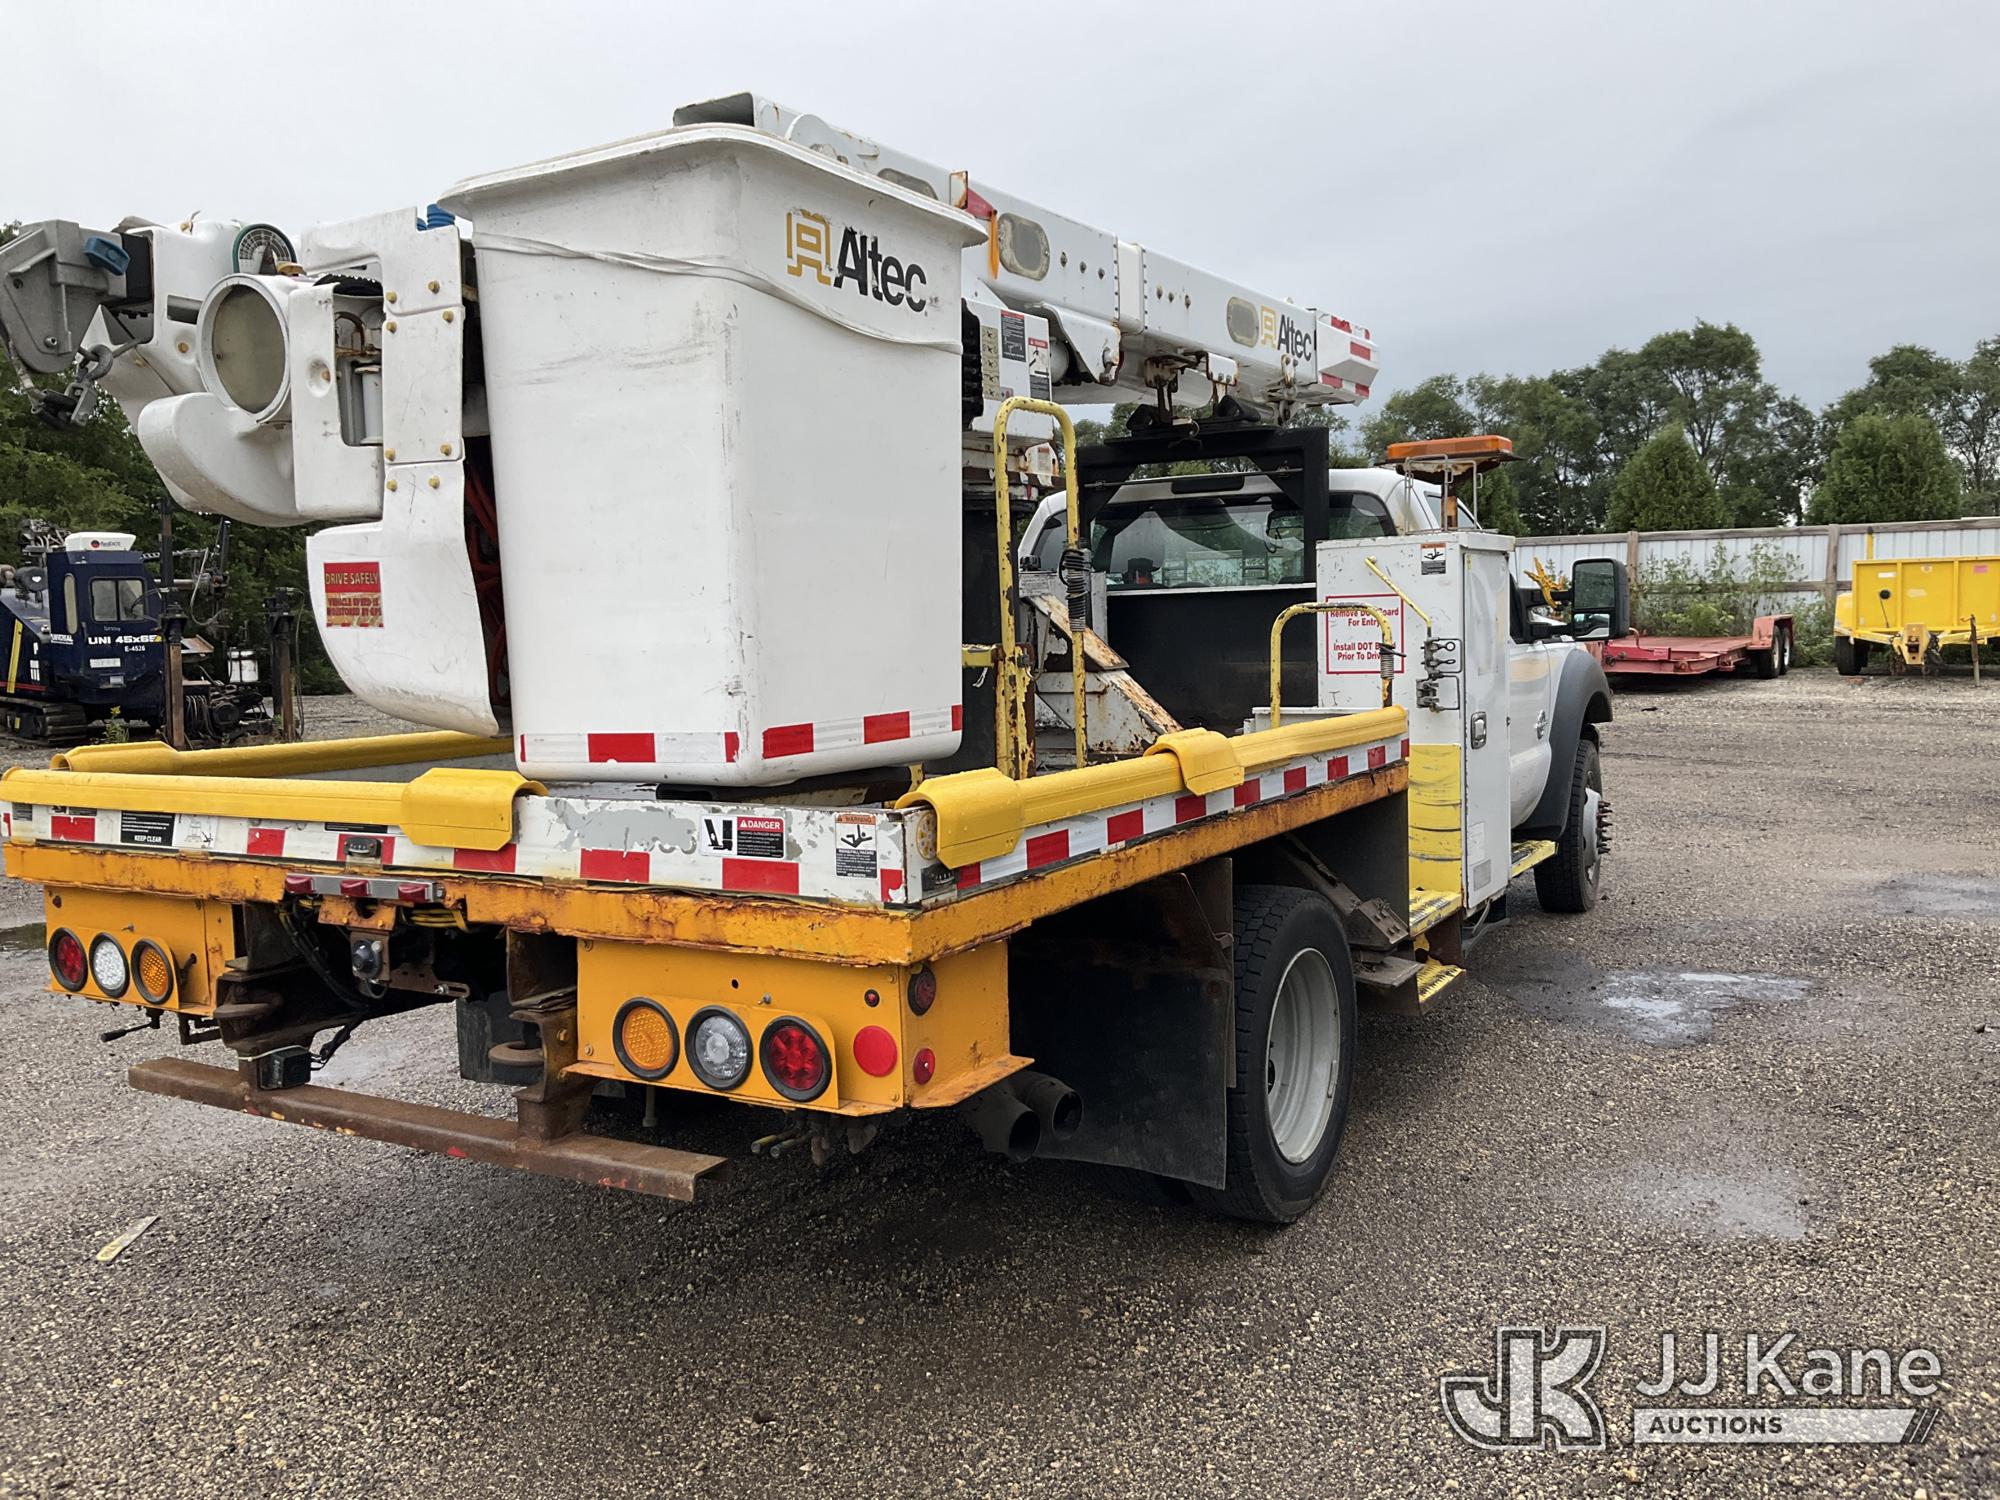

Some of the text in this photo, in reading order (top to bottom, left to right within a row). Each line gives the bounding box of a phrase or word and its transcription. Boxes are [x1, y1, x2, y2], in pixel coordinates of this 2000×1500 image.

[834, 226, 927, 312] Altec
[1277, 314, 1312, 362] Altec
[325, 572, 378, 585] DRIVE SAFELY
[1330, 610, 1358, 618] Remove
[1347, 618, 1380, 628] For Entry
[88, 637, 111, 645] UNI
[1333, 643, 1356, 652] Install
[1357, 642, 1373, 651] DOT
[1337, 652, 1355, 661] Prior
[1356, 651, 1365, 660] To
[845, 815, 872, 823] WARNING
[747, 820, 781, 830] DANGER
[146, 835, 162, 844] CLEAR
